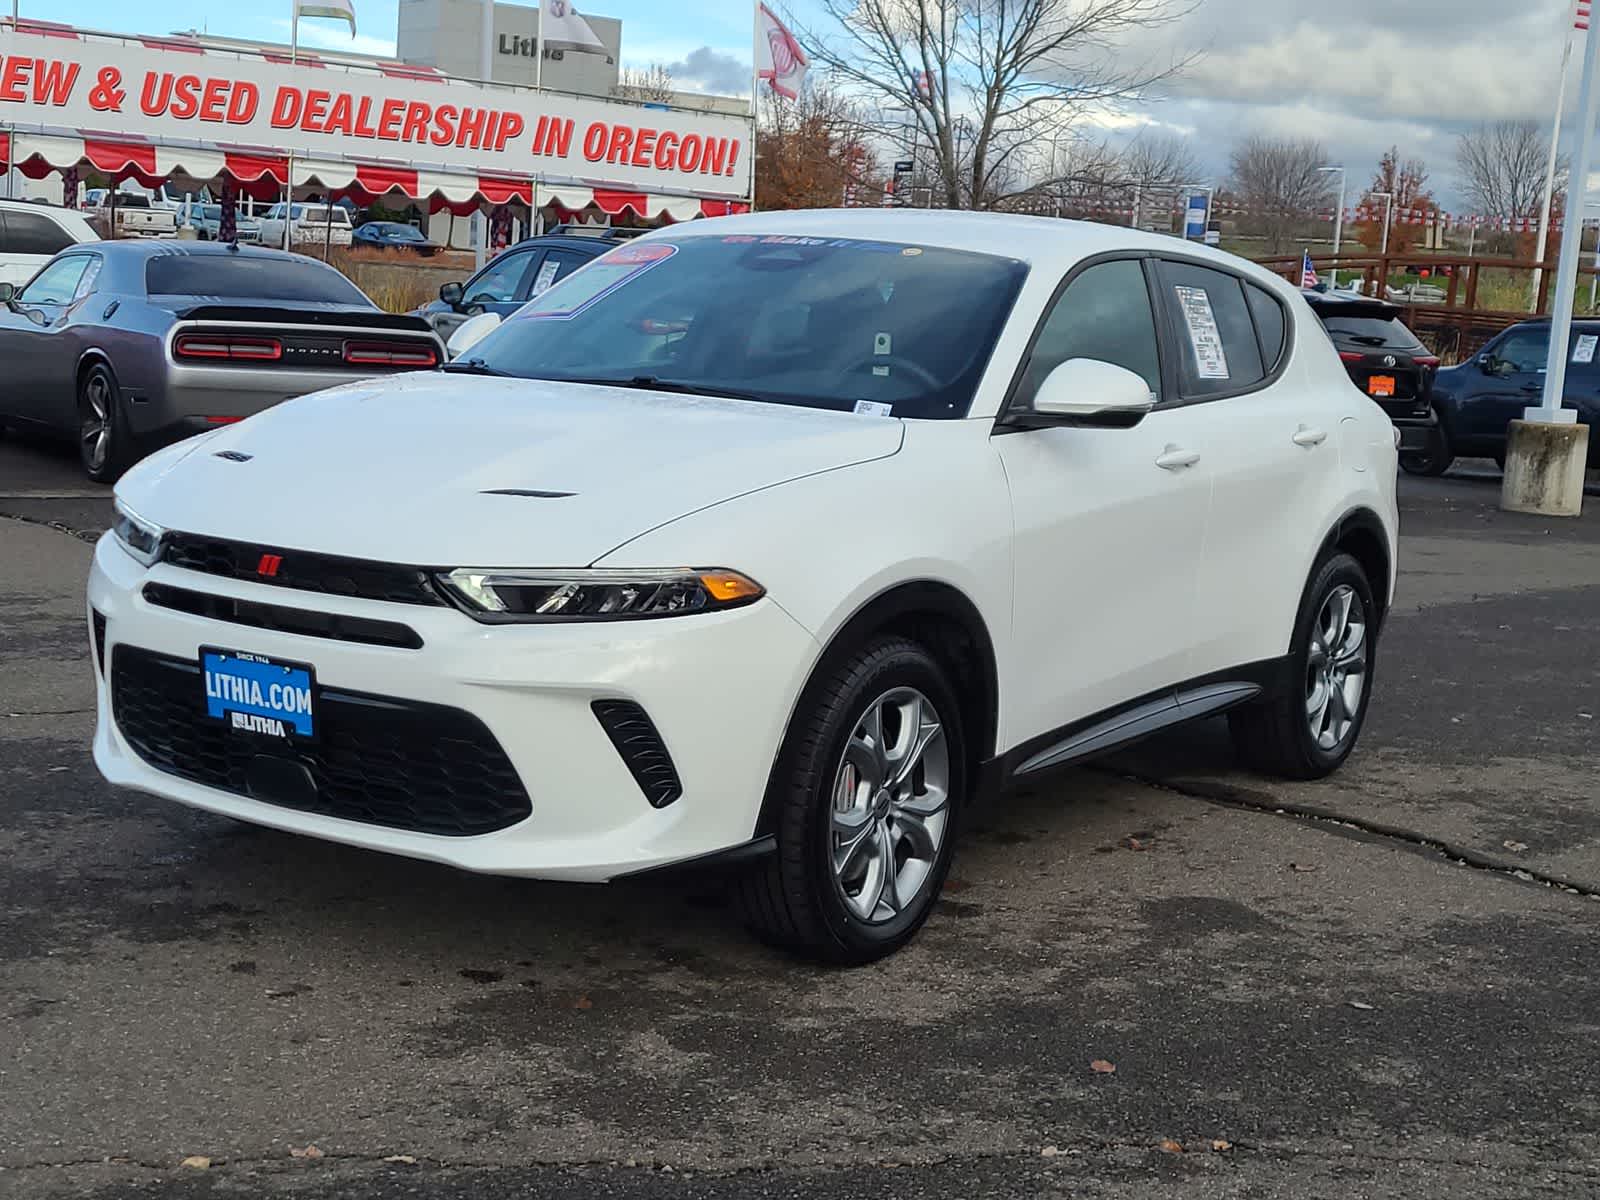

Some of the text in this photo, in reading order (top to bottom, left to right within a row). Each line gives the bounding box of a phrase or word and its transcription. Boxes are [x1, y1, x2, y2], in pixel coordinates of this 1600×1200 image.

[0, 54, 740, 177] EW & USED DEALERSHIP IN OREGON!
[205, 670, 313, 715] LITHIA.COM
[244, 713, 286, 737] LITHIA
